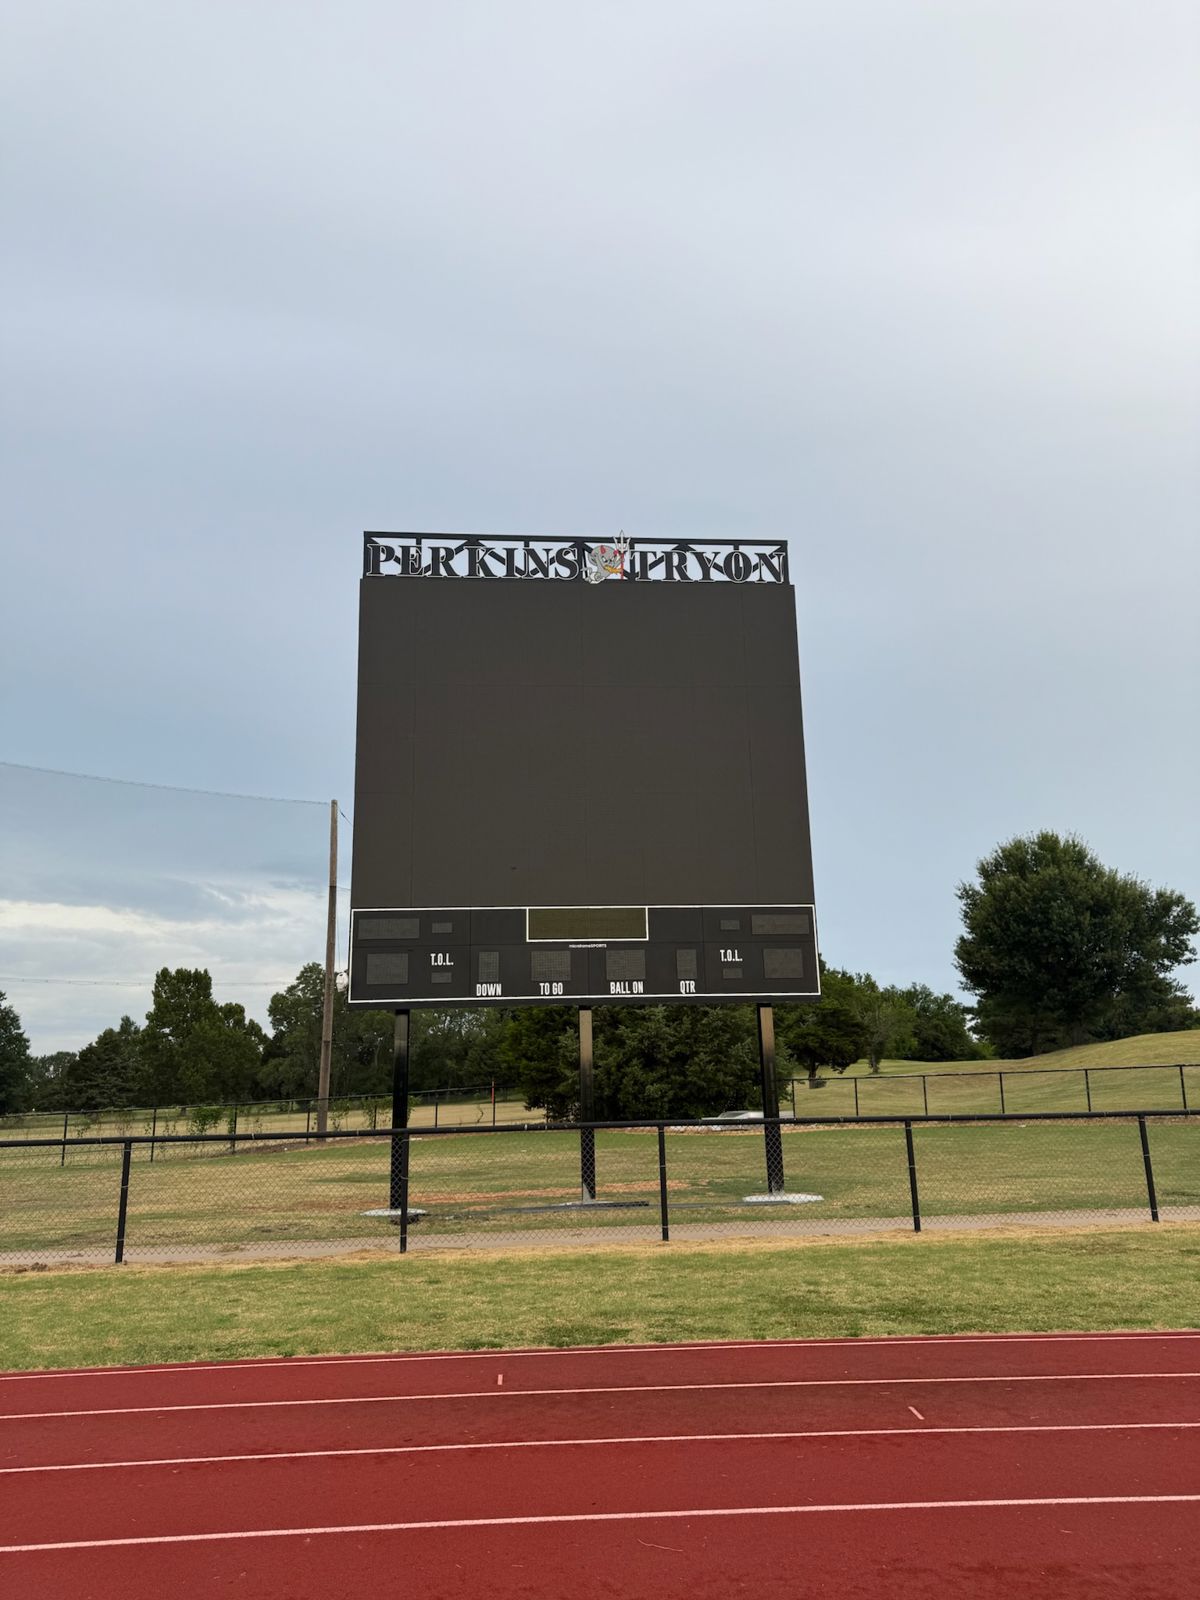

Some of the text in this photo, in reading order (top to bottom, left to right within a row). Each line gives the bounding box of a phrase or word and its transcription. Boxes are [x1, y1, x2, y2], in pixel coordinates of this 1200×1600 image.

[367, 544, 786, 583] PERKINS TRYON
[430, 953, 454, 966] T.O.L.
[720, 949, 743, 962] T.O.L.
[476, 983, 502, 996] DOWN
[540, 982, 564, 995] TO GO
[610, 981, 644, 994] BALL ON
[680, 980, 696, 994] QTR
